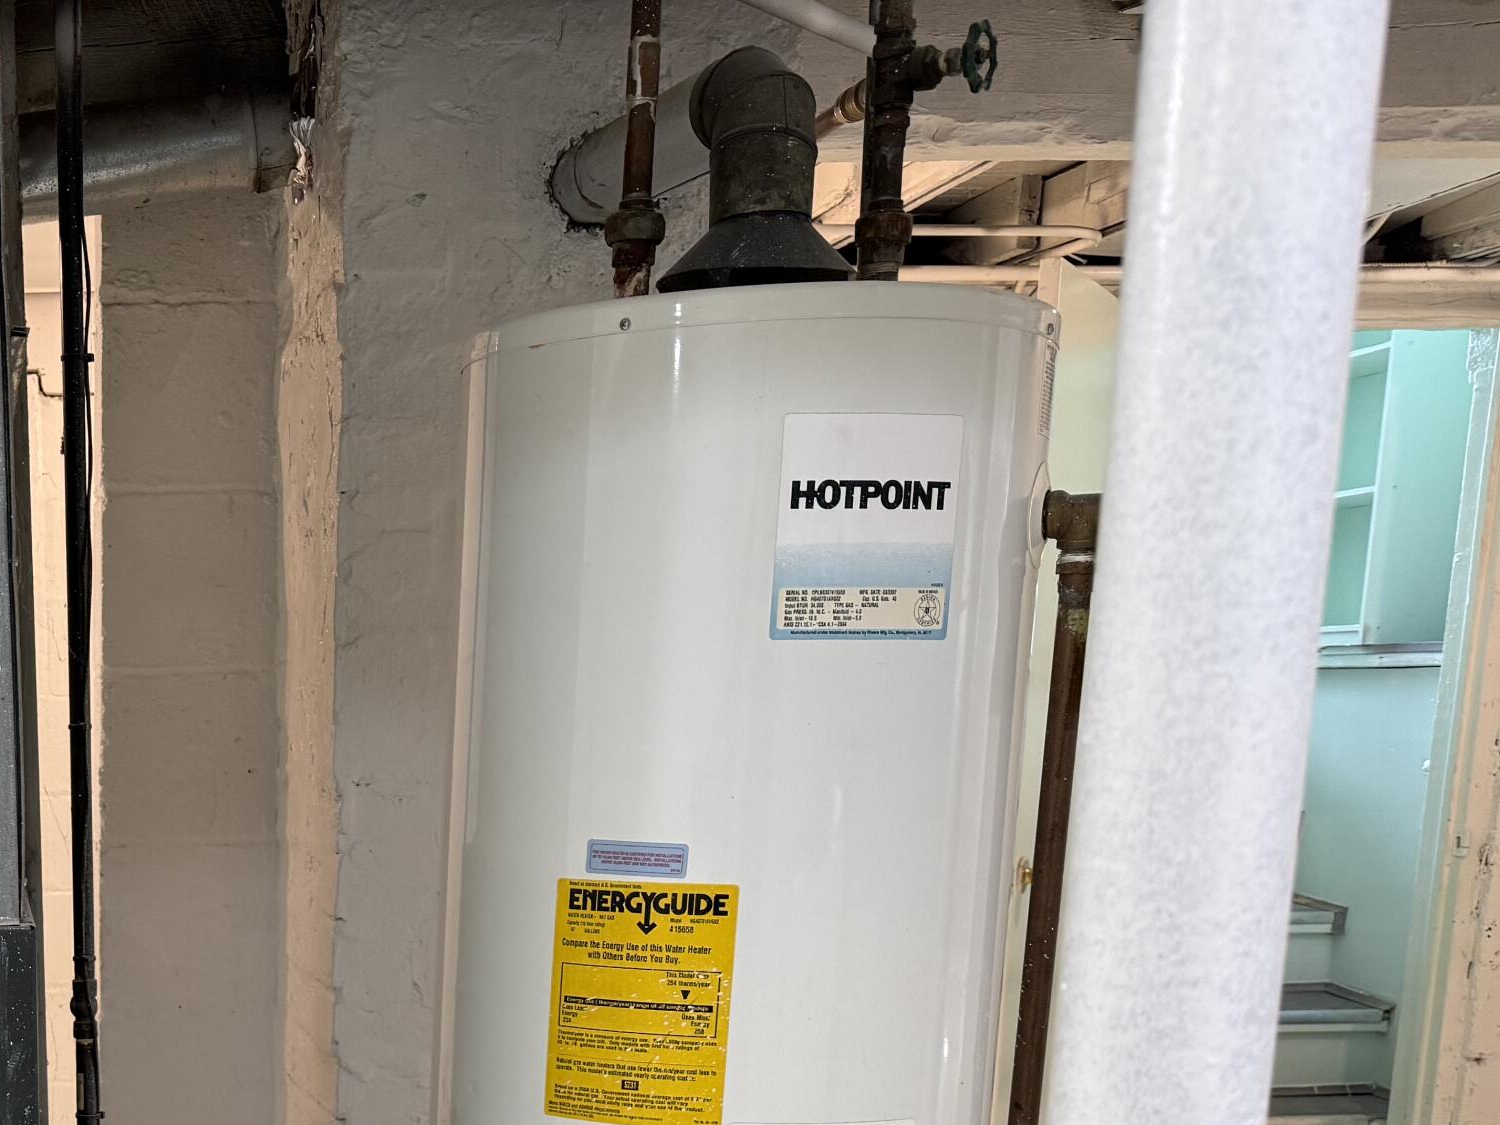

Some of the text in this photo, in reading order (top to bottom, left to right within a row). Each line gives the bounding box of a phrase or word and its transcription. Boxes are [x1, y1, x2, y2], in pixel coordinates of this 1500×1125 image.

[790, 479, 951, 511] HOTPOINT
[569, 888, 729, 917] ENERGYGUIDE
[561, 937, 711, 954] Compare the Energy Use of this Water Heater
[588, 951, 681, 965] with Others Before You Buy.
[561, 1010, 578, 1018] Energy
